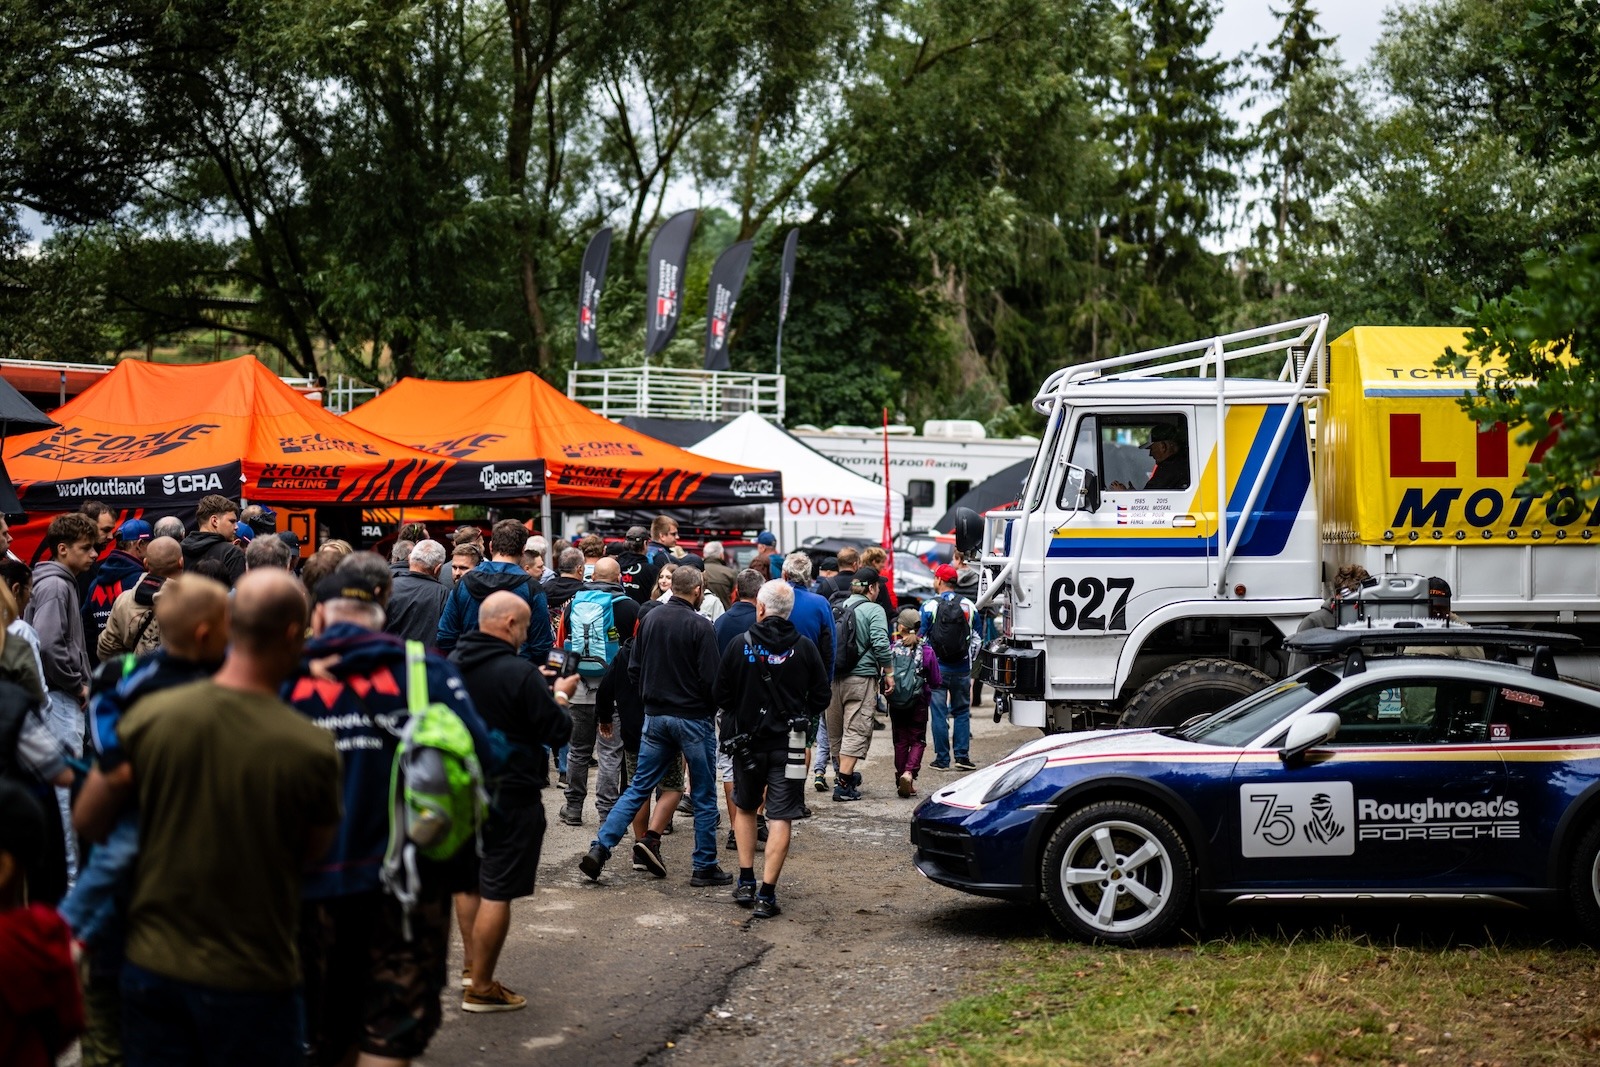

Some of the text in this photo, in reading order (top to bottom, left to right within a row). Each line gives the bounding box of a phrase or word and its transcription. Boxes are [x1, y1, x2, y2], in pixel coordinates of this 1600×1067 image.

[1386, 368, 1533, 380] TCHEC
[260, 463, 346, 478] X-FORCE
[562, 464, 627, 478] X-FORCE
[924, 458, 969, 471] Racing
[56, 477, 146, 498] workoutland
[178, 473, 223, 493] CRA
[271, 479, 329, 490] RACING
[1050, 577, 1135, 631] 627
[1493, 727, 1507, 737] 02
[1359, 796, 1520, 824] Roughroads
[1250, 794, 1295, 846] 75
[1359, 826, 1521, 842] PORSCHE
